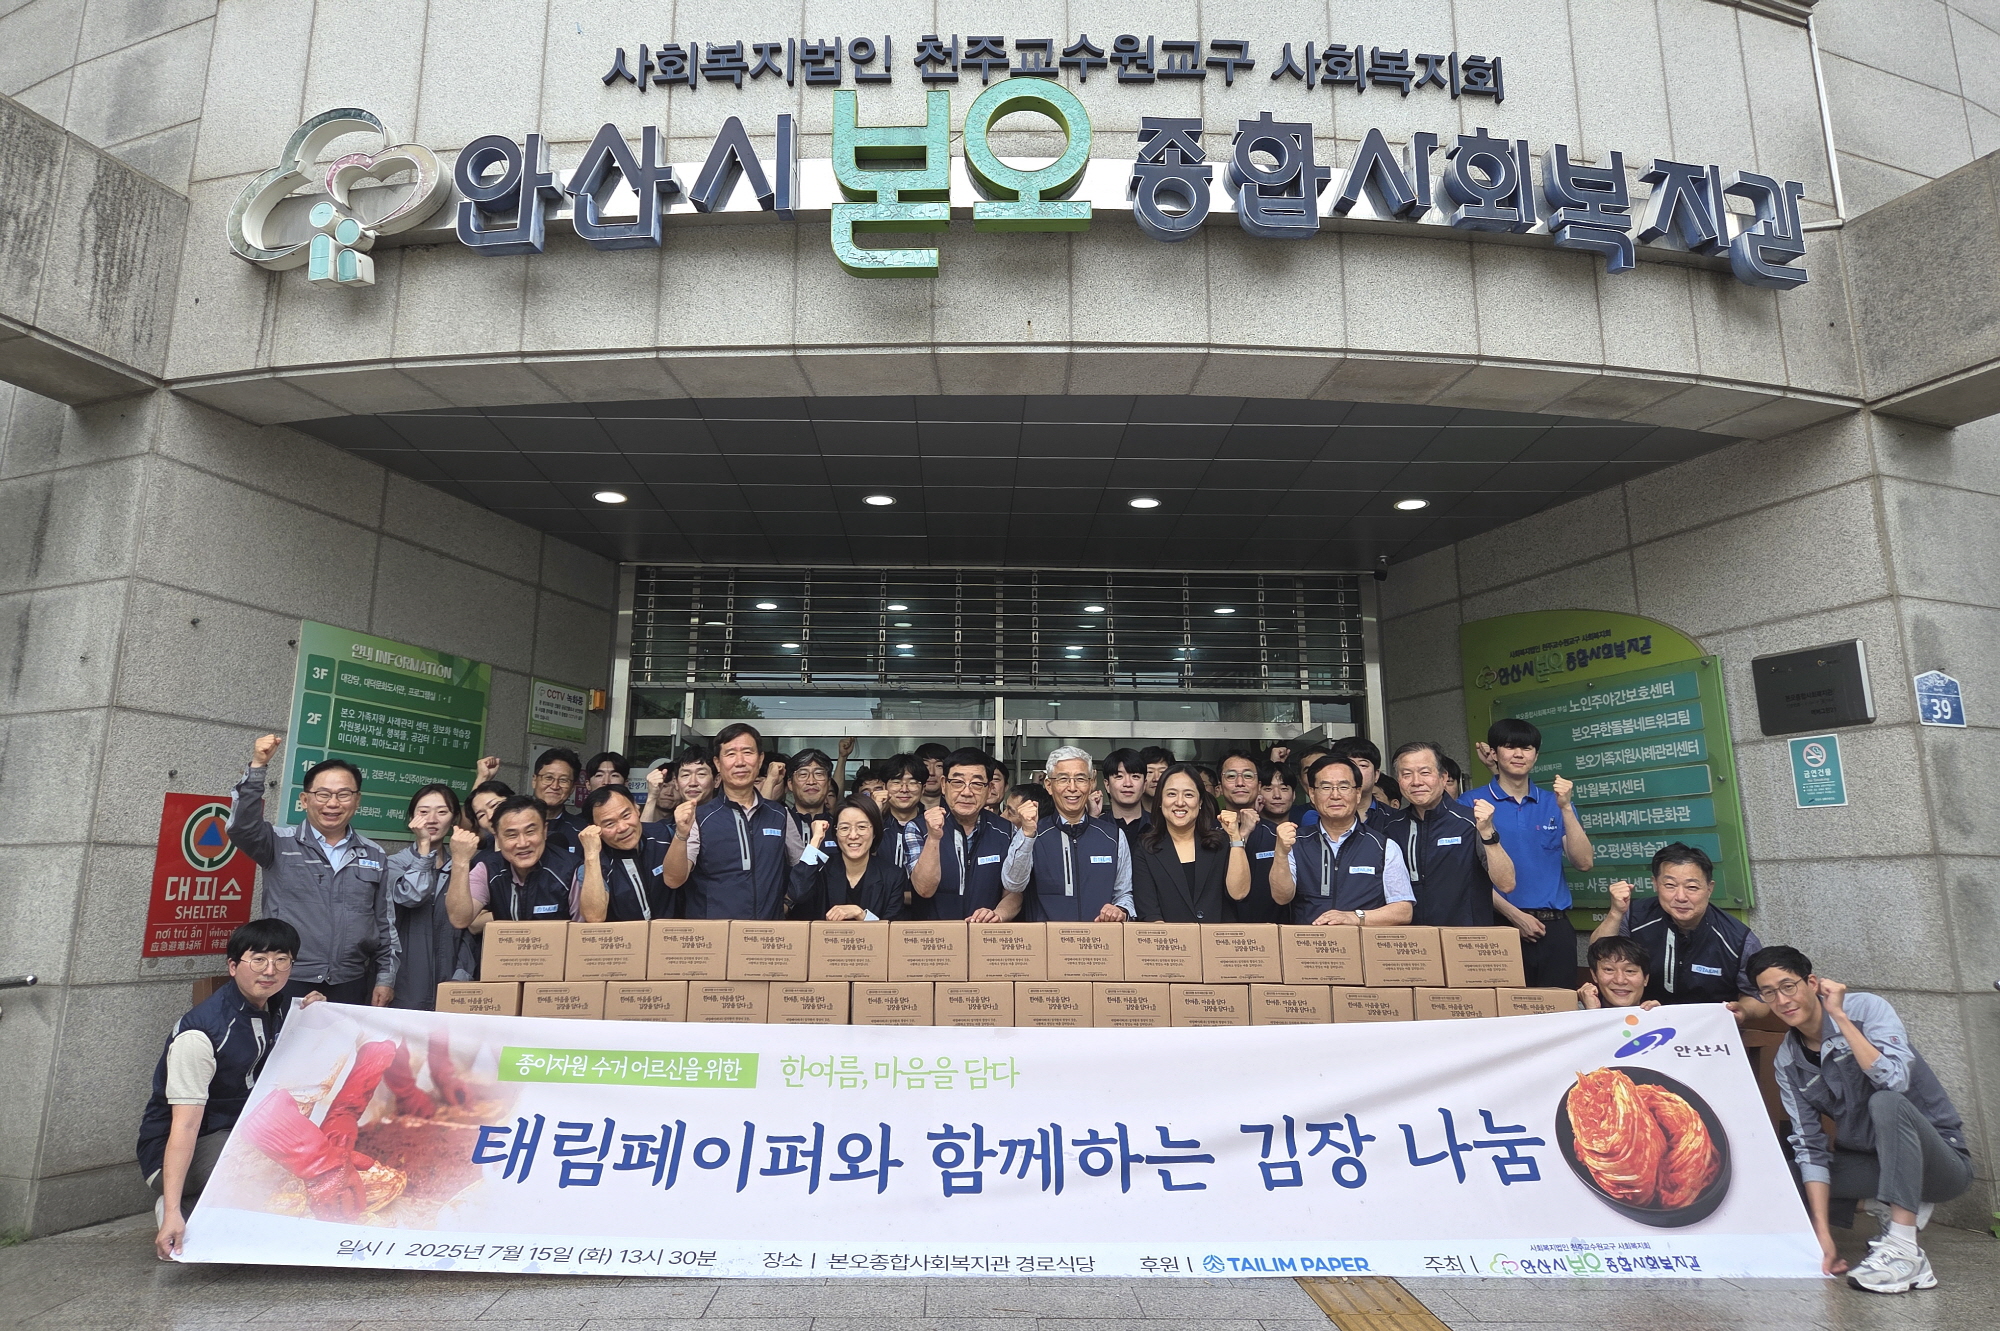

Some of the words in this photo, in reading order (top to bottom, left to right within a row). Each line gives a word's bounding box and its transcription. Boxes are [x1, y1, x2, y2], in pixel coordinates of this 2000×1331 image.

[602, 34, 892, 91] 사회복지법인
[913, 33, 1256, 86] 천주교수원교구
[1278, 40, 1504, 104] 사회복지회
[454, 113, 796, 256] 안산시
[831, 76, 1092, 278] 본오
[1131, 111, 1809, 291] 종합사회복지관
[351, 643, 372, 661] 안내
[375, 649, 452, 680] INFORMATION
[1498, 661, 1534, 686] 안산시
[1535, 651, 1564, 683] 본오
[1566, 634, 1652, 671] 종합사회복지관
[312, 667, 329, 680] 3F
[547, 689, 565, 701] CCTV
[1569, 680, 1675, 713] 노인주야간보호센터
[306, 712, 322, 725] 2F
[340, 707, 356, 719] 본오
[358, 710, 386, 724] 가족지원
[386, 716, 414, 730] 사례관리
[1930, 698, 1952, 720] 39
[1571, 709, 1691, 742] 본오무한돌봄네트워크팀
[371, 738, 406, 753] 피아노교실
[1575, 739, 1700, 770] 본오가족지원사례관리센터
[371, 769, 397, 783] 경로식당,
[1576, 778, 1645, 798] 반월복지센터
[354, 806, 382, 818] 다문화관,
[1581, 805, 1690, 828] 열려라세계다문화관
[165, 876, 242, 901] 대피소
[175, 905, 228, 919] SHELTER
[173, 926, 188, 939] trú
[211, 939, 229, 949] 待避
[1674, 1044, 1731, 1058] 안산시
[515, 1053, 588, 1078] 종이자원
[591, 1055, 628, 1079] 수거
[631, 1056, 702, 1081] 어르신을
[704, 1058, 742, 1082] 위한
[780, 1055, 868, 1090] 한여름,
[875, 1055, 959, 1090] 마음을
[965, 1055, 1021, 1090] 담다
[472, 1113, 904, 1195] 태림페이퍼와
[926, 1121, 1216, 1197] 함께하는
[1240, 1113, 1376, 1192] 김장
[1398, 1107, 1546, 1187] 나눔
[336, 1239, 383, 1257] 일시
[405, 1242, 485, 1260] 2025년
[488, 1244, 522, 1262] 7월
[528, 1246, 573, 1264] 15일
[577, 1247, 613, 1265] (화)
[620, 1248, 663, 1266] 13시
[667, 1249, 718, 1267] 30분
[762, 1252, 803, 1269] 장소
[828, 1253, 1011, 1273] 본오종합사회복지관
[1015, 1255, 1096, 1273] 경로식당
[1520, 1258, 1567, 1274] 안산시
[1565, 1252, 1604, 1276] 본오
[1605, 1254, 1703, 1273] 종합사회복지관
[1140, 1256, 1180, 1273] 후원
[1227, 1257, 1298, 1272] TAILIM
[1300, 1257, 1372, 1272] PAPER
[1424, 1255, 1466, 1274] 주최
